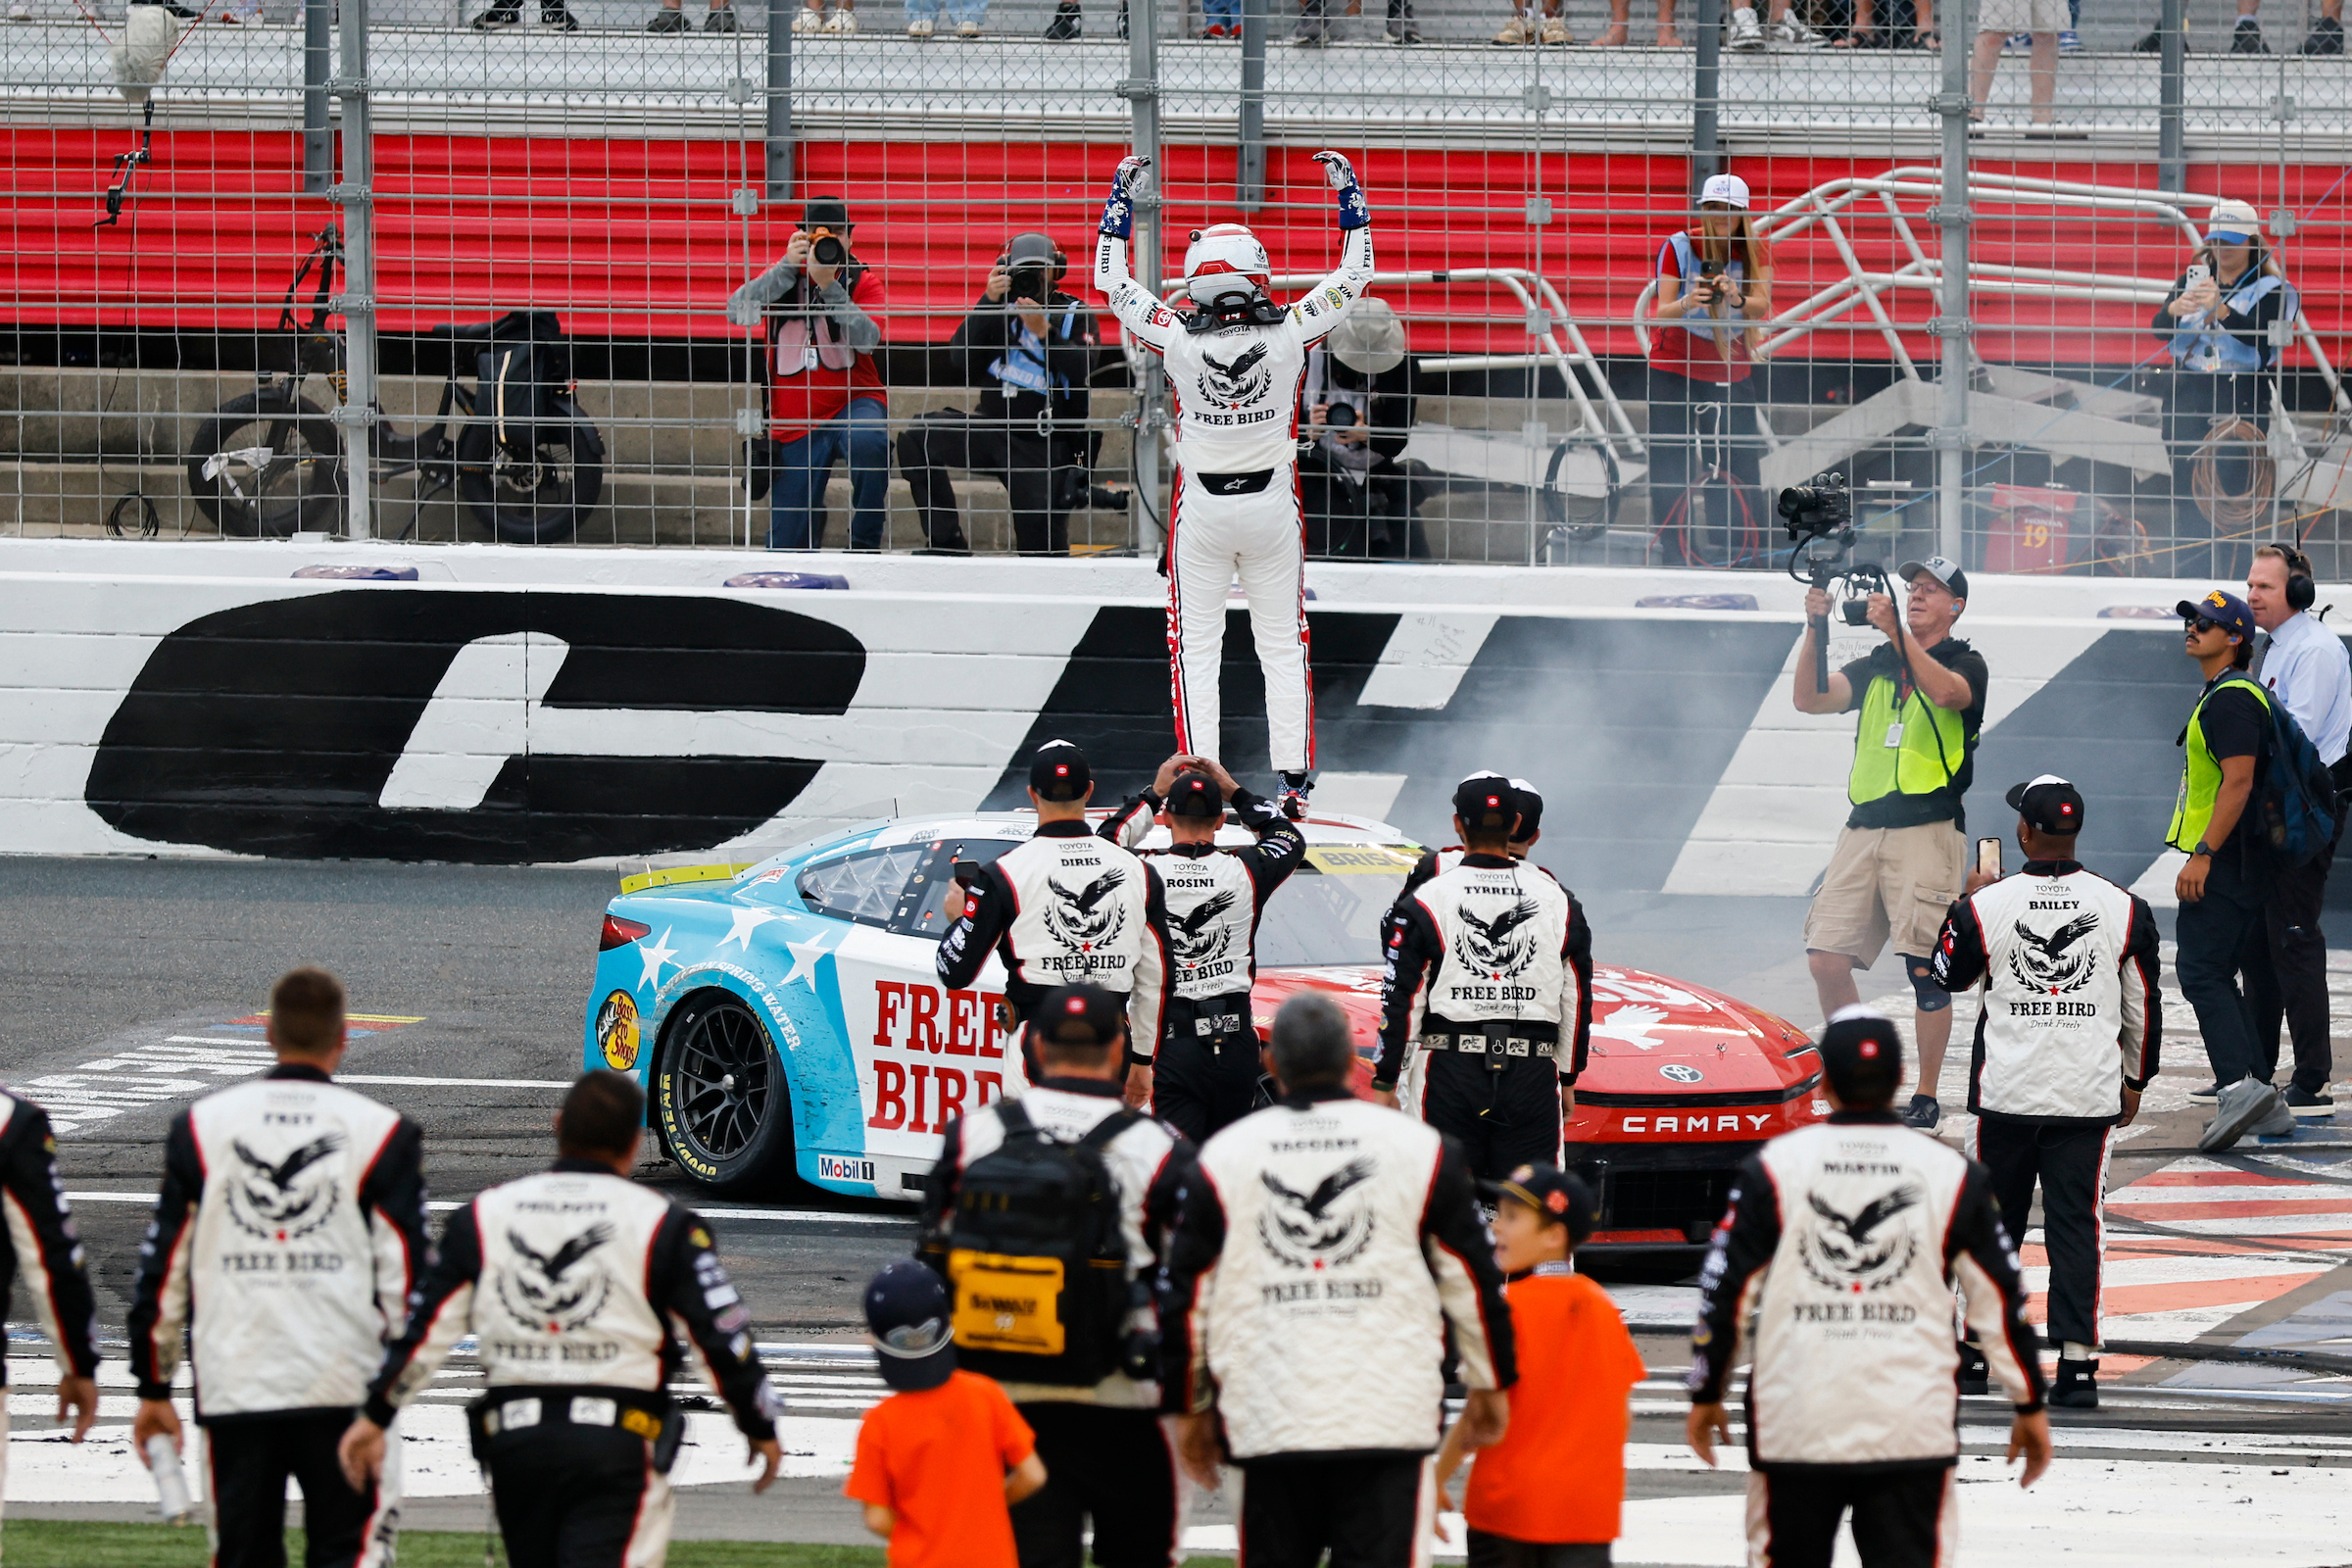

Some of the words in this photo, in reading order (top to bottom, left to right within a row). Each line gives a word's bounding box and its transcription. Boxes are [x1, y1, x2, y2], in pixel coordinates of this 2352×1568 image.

[1219, 325, 1251, 337] TOYOTA
[1195, 411, 1234, 425] FREE
[1237, 409, 1276, 424] BIRD
[2022, 524, 2049, 549] 19
[1060, 858, 1102, 867] DIRKS
[1166, 878, 1215, 888] ROSINI
[1464, 886, 1527, 897] TYRRELL
[2029, 901, 2081, 910] BAILEY
[1041, 956, 1086, 970] FREE
[1089, 955, 1127, 969] BIRD
[1198, 959, 1234, 981] BIRD
[1200, 980, 1225, 993] Freely
[1450, 987, 1497, 1001] FREE
[1501, 987, 1537, 1001] BIRD
[616, 995, 634, 1022] Bass
[715, 961, 767, 994] SPRING
[761, 992, 803, 1052] WATER
[1474, 1003, 1499, 1012] Drink
[2009, 1003, 2052, 1016] FREE
[2056, 1002, 2096, 1017] BIRD
[873, 980, 1004, 1059] FREE
[2030, 1019, 2053, 1029] Drink
[2056, 1019, 2082, 1030] Freely
[615, 1018, 628, 1041] Pro
[612, 1035, 635, 1067] Shops
[1622, 1114, 1772, 1133] CAMRY
[820, 1157, 859, 1180] Mobil
[1823, 1160, 1902, 1175] MARTIN
[221, 1251, 278, 1272] FREE
[287, 1250, 344, 1271] BIRD
[1791, 1302, 1854, 1322] FREE
[1863, 1302, 1917, 1323] BIRD
